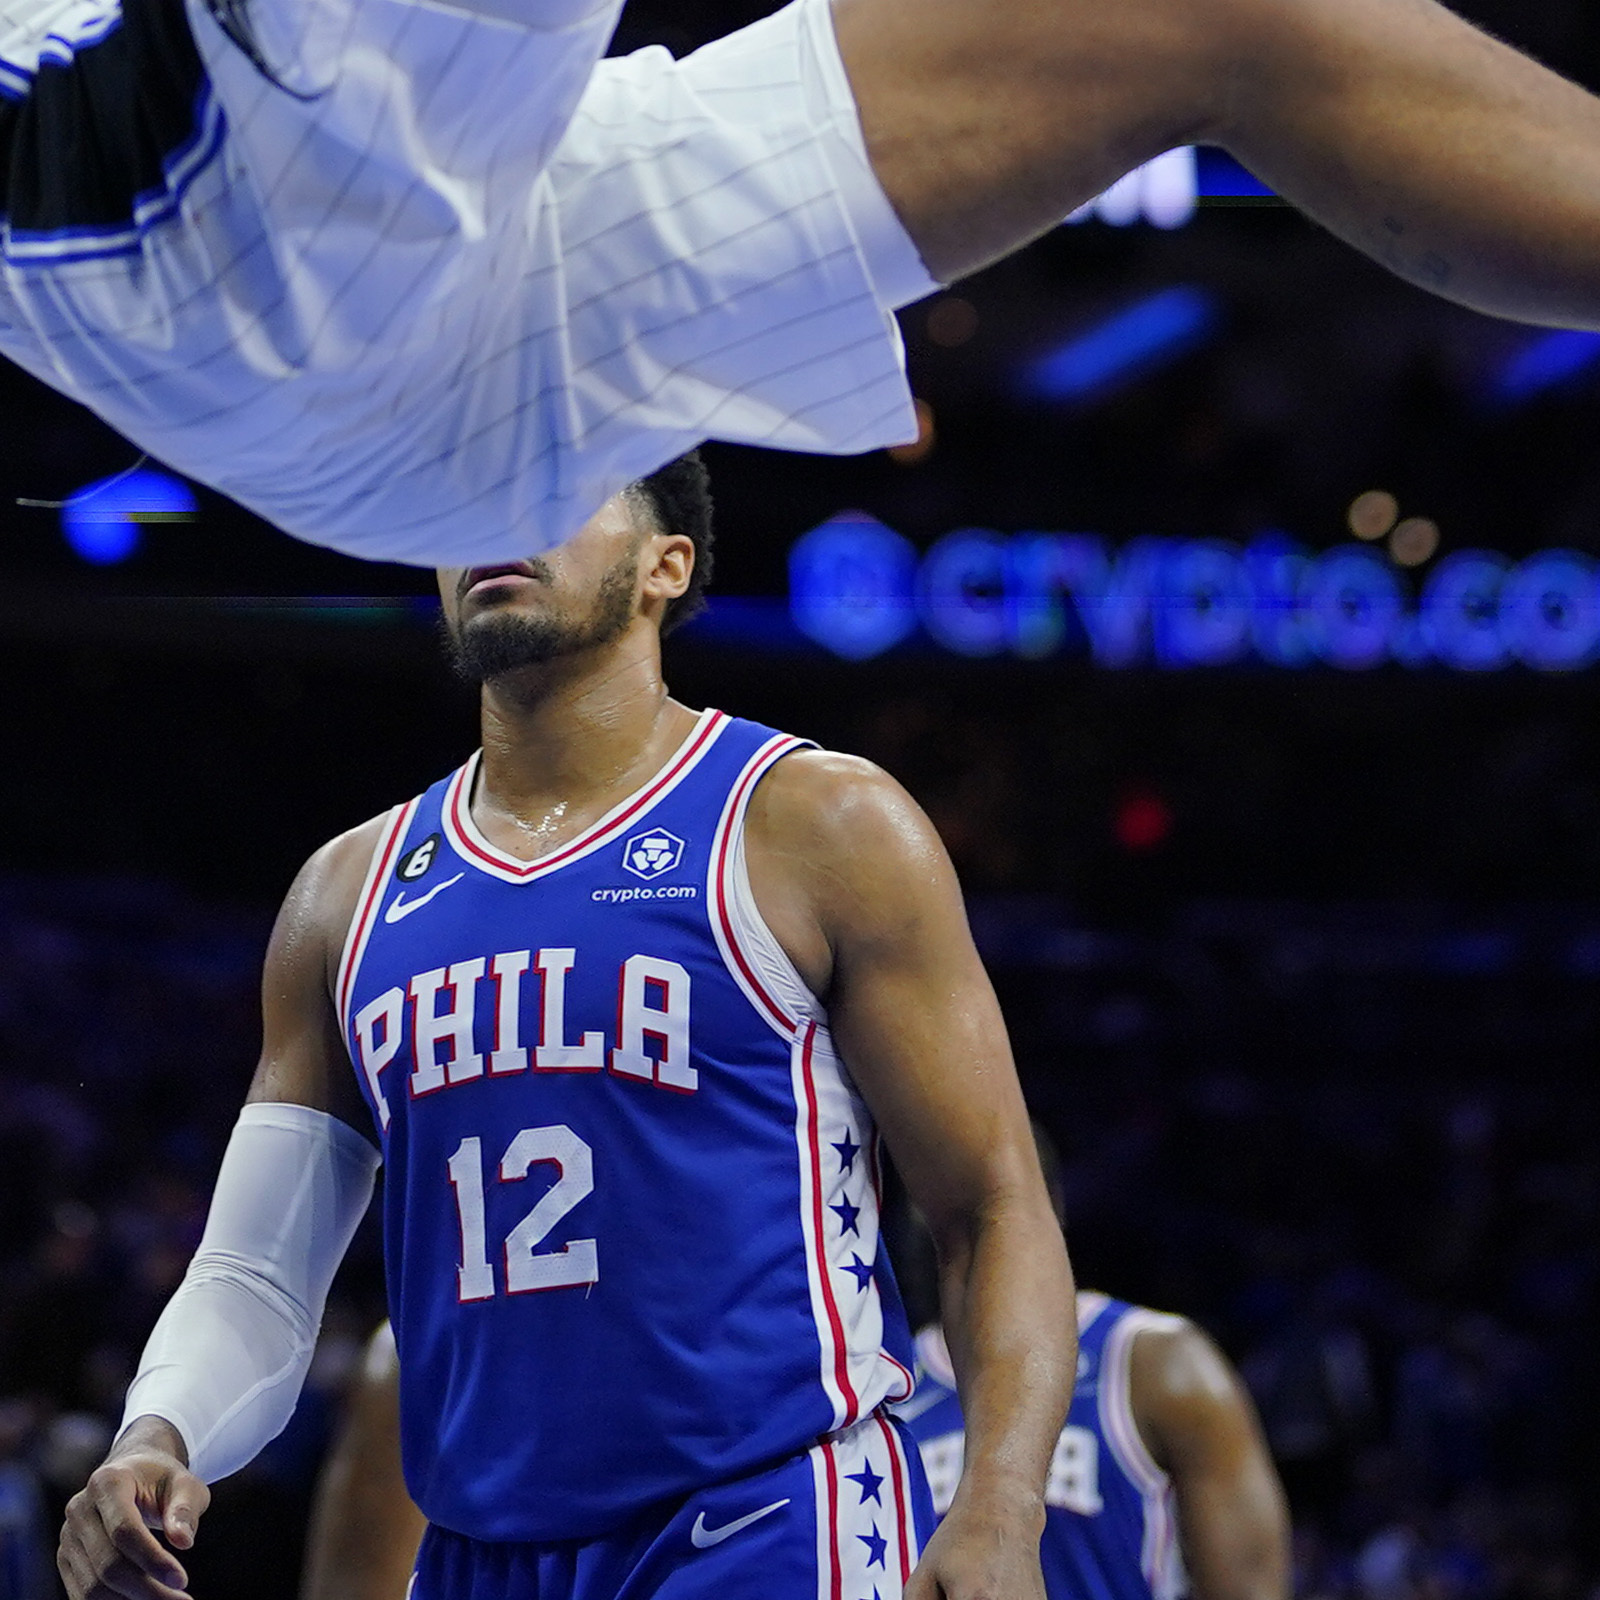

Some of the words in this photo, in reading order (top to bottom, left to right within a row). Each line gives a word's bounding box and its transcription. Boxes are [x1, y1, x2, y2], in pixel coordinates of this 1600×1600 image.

[403, 839, 435, 878] 6
[591, 886, 697, 904] crypto.com
[354, 946, 699, 1133] PHILA
[448, 1123, 600, 1304] 12
